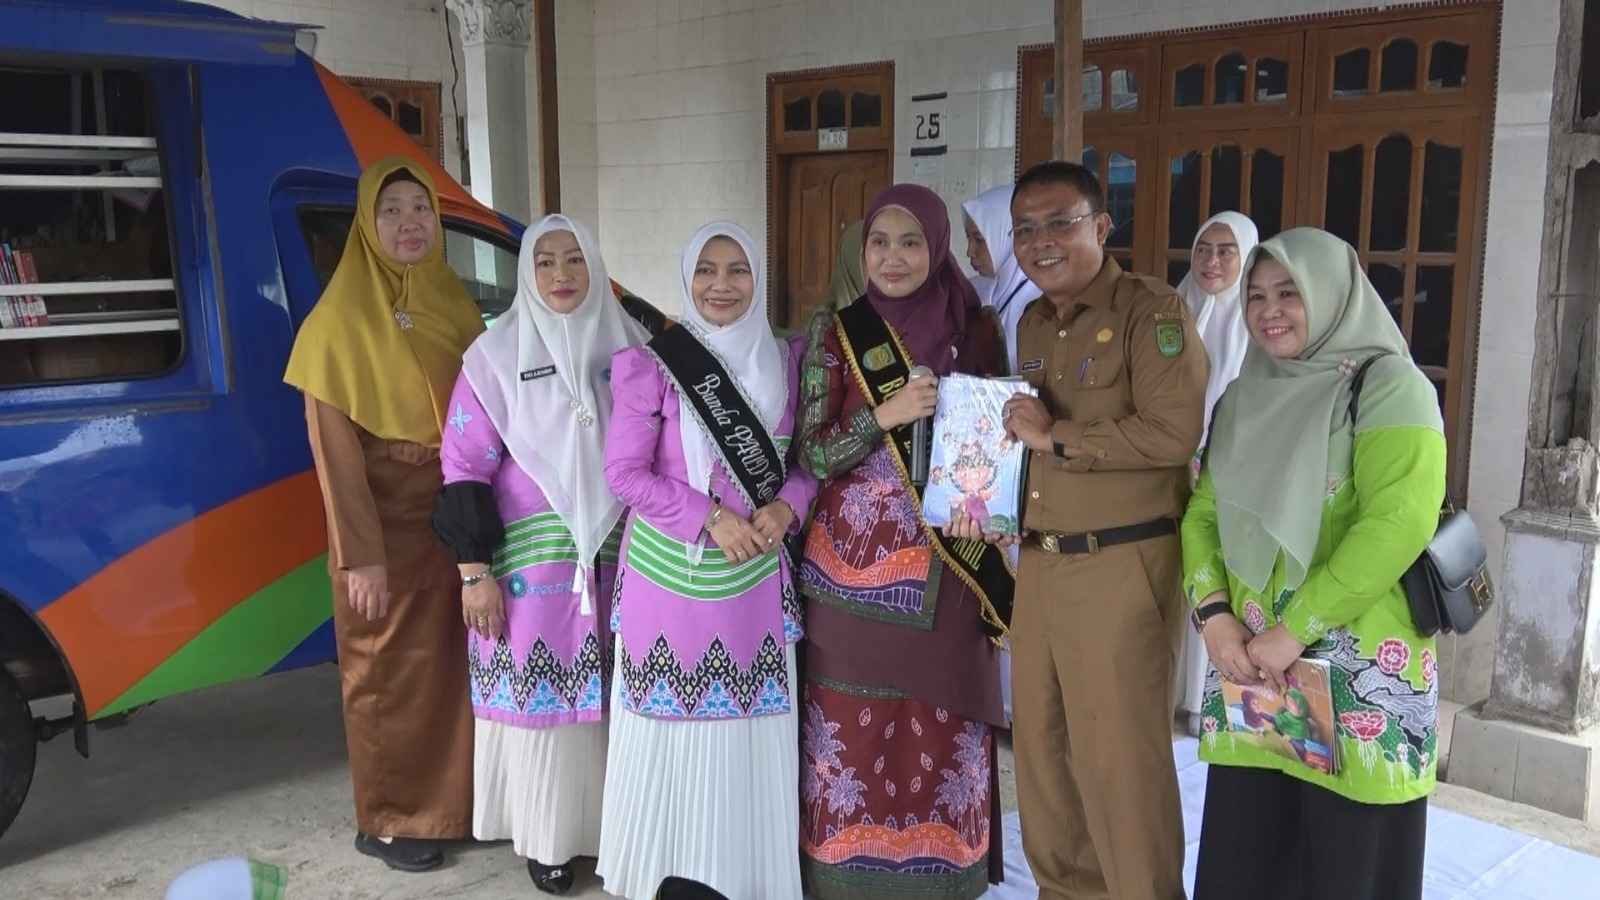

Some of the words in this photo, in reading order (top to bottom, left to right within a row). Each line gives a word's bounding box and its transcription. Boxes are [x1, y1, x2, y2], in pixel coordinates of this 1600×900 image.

[915, 113, 941, 140] 25
[693, 373, 739, 427] Bunda
[724, 425, 769, 476] PAUD
